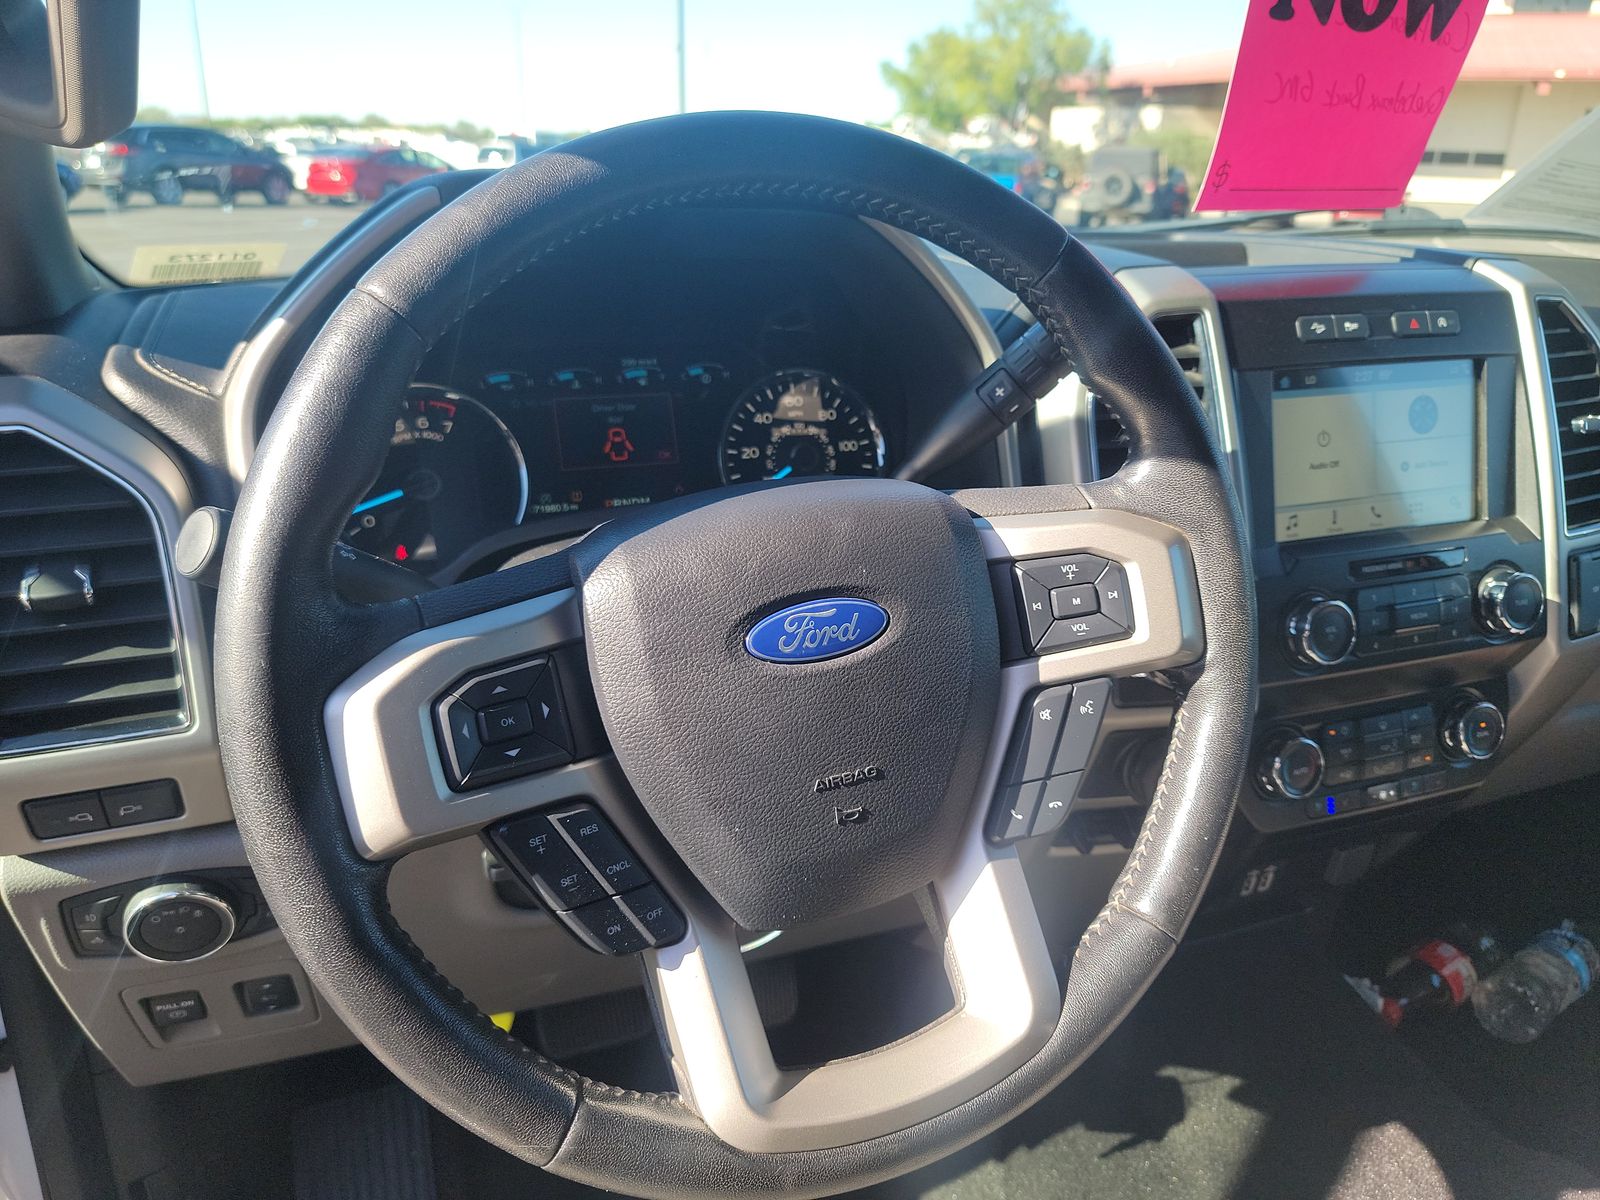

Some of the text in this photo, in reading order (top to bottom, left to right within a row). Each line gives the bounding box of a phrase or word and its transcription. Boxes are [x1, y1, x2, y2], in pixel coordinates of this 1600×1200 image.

[753, 412, 774, 425] 40
[818, 409, 838, 421] 80
[417, 417, 429, 429] 6
[442, 421, 453, 434] 7
[838, 440, 859, 452] 100
[741, 447, 760, 460] 20
[1061, 564, 1080, 574] VOL
[1072, 597, 1082, 606] M
[778, 608, 861, 654] Ford
[1071, 623, 1091, 633] VOL
[500, 715, 516, 728] OK
[813, 764, 879, 793] AIRBAG
[580, 824, 599, 838] RES
[529, 834, 548, 848] SET
[606, 860, 632, 875] CNCL
[560, 874, 578, 888] SET
[647, 906, 664, 921] OFF
[607, 923, 622, 936] ON
